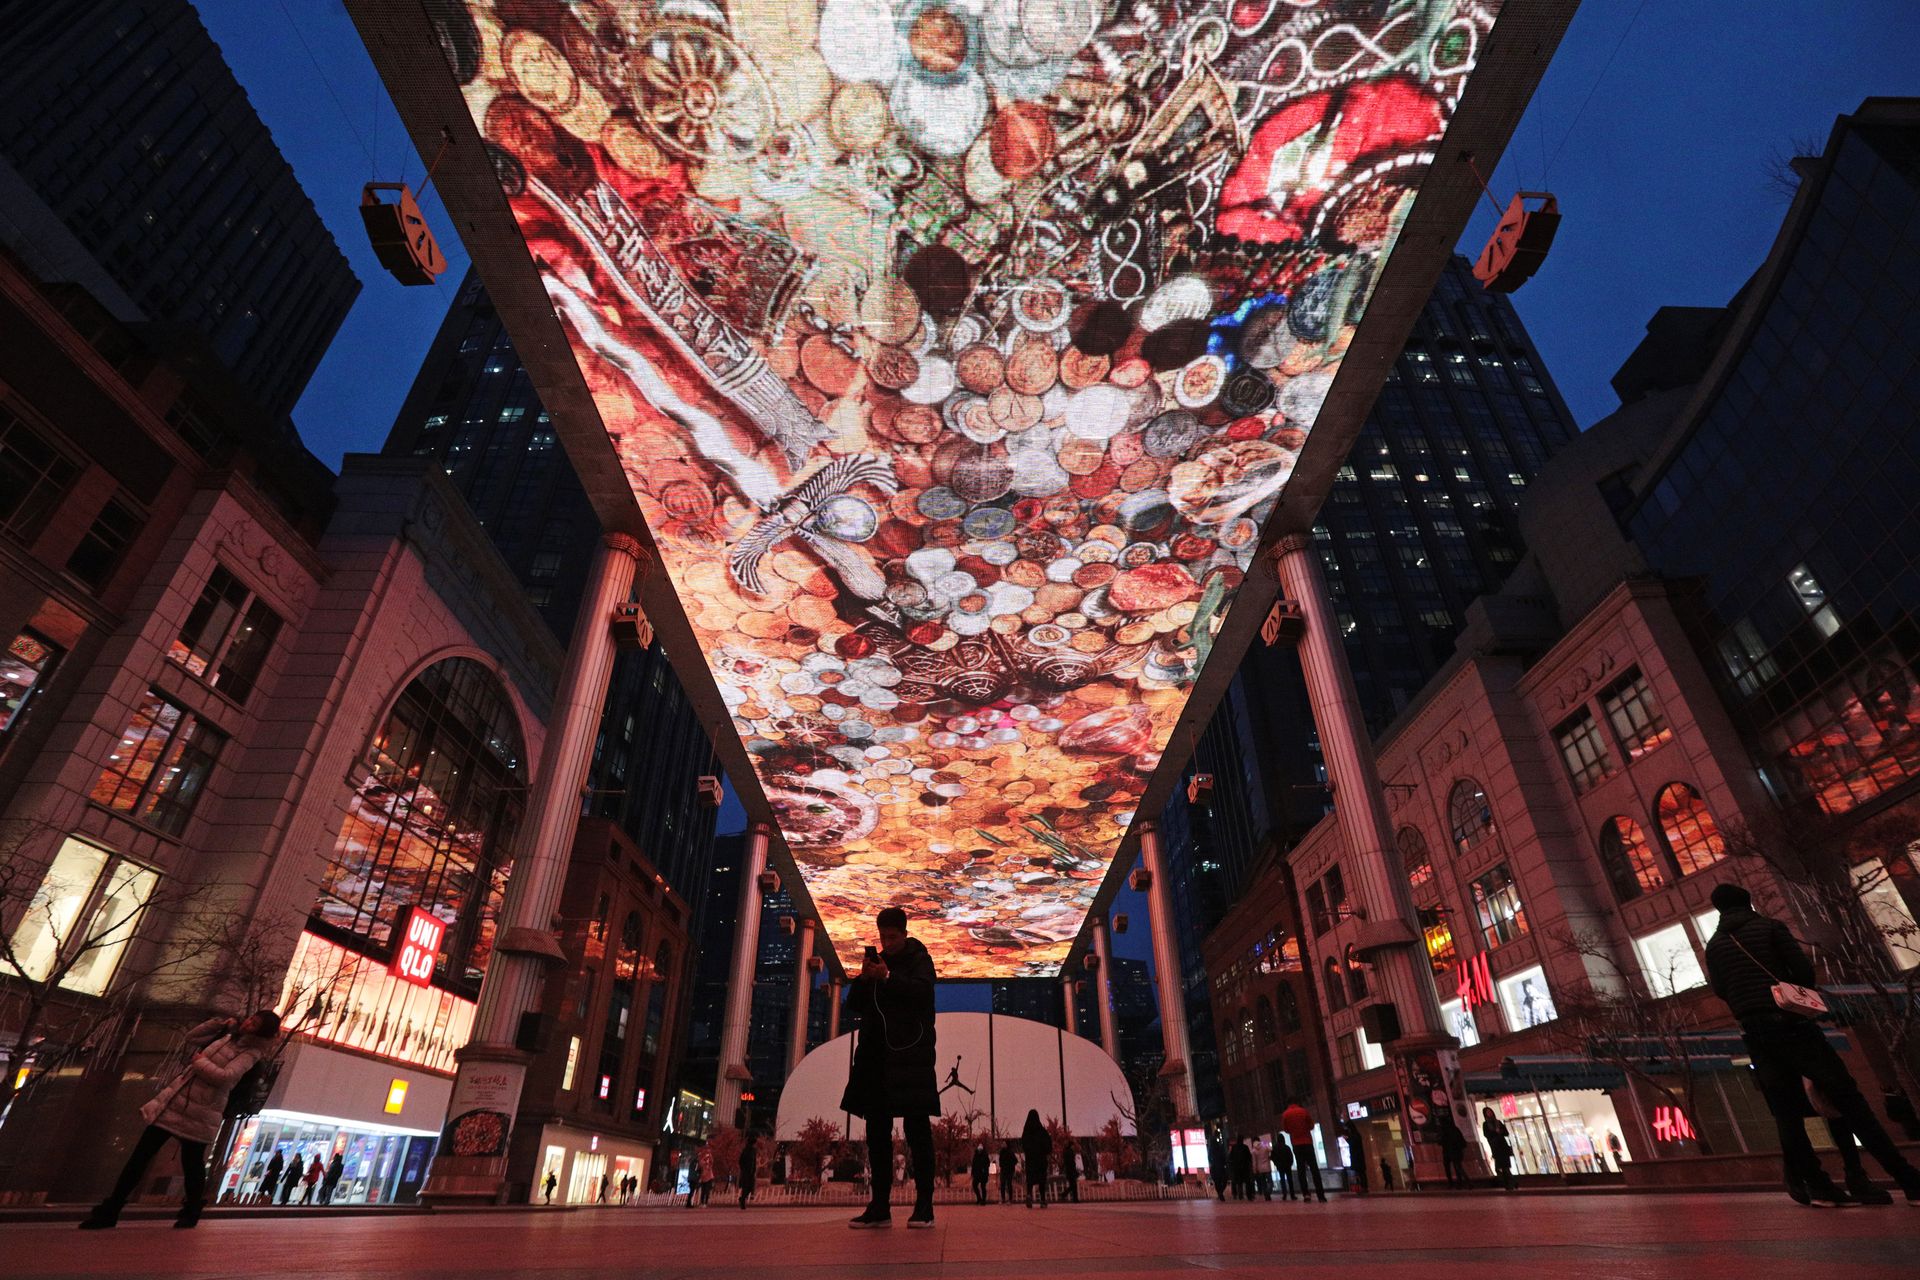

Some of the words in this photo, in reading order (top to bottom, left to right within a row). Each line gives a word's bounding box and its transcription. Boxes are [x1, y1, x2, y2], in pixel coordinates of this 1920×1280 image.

[409, 915, 440, 951] UNI
[400, 945, 433, 979] QLO
[1456, 949, 1496, 1013] H&M
[1652, 1105, 1696, 1142] H&M
